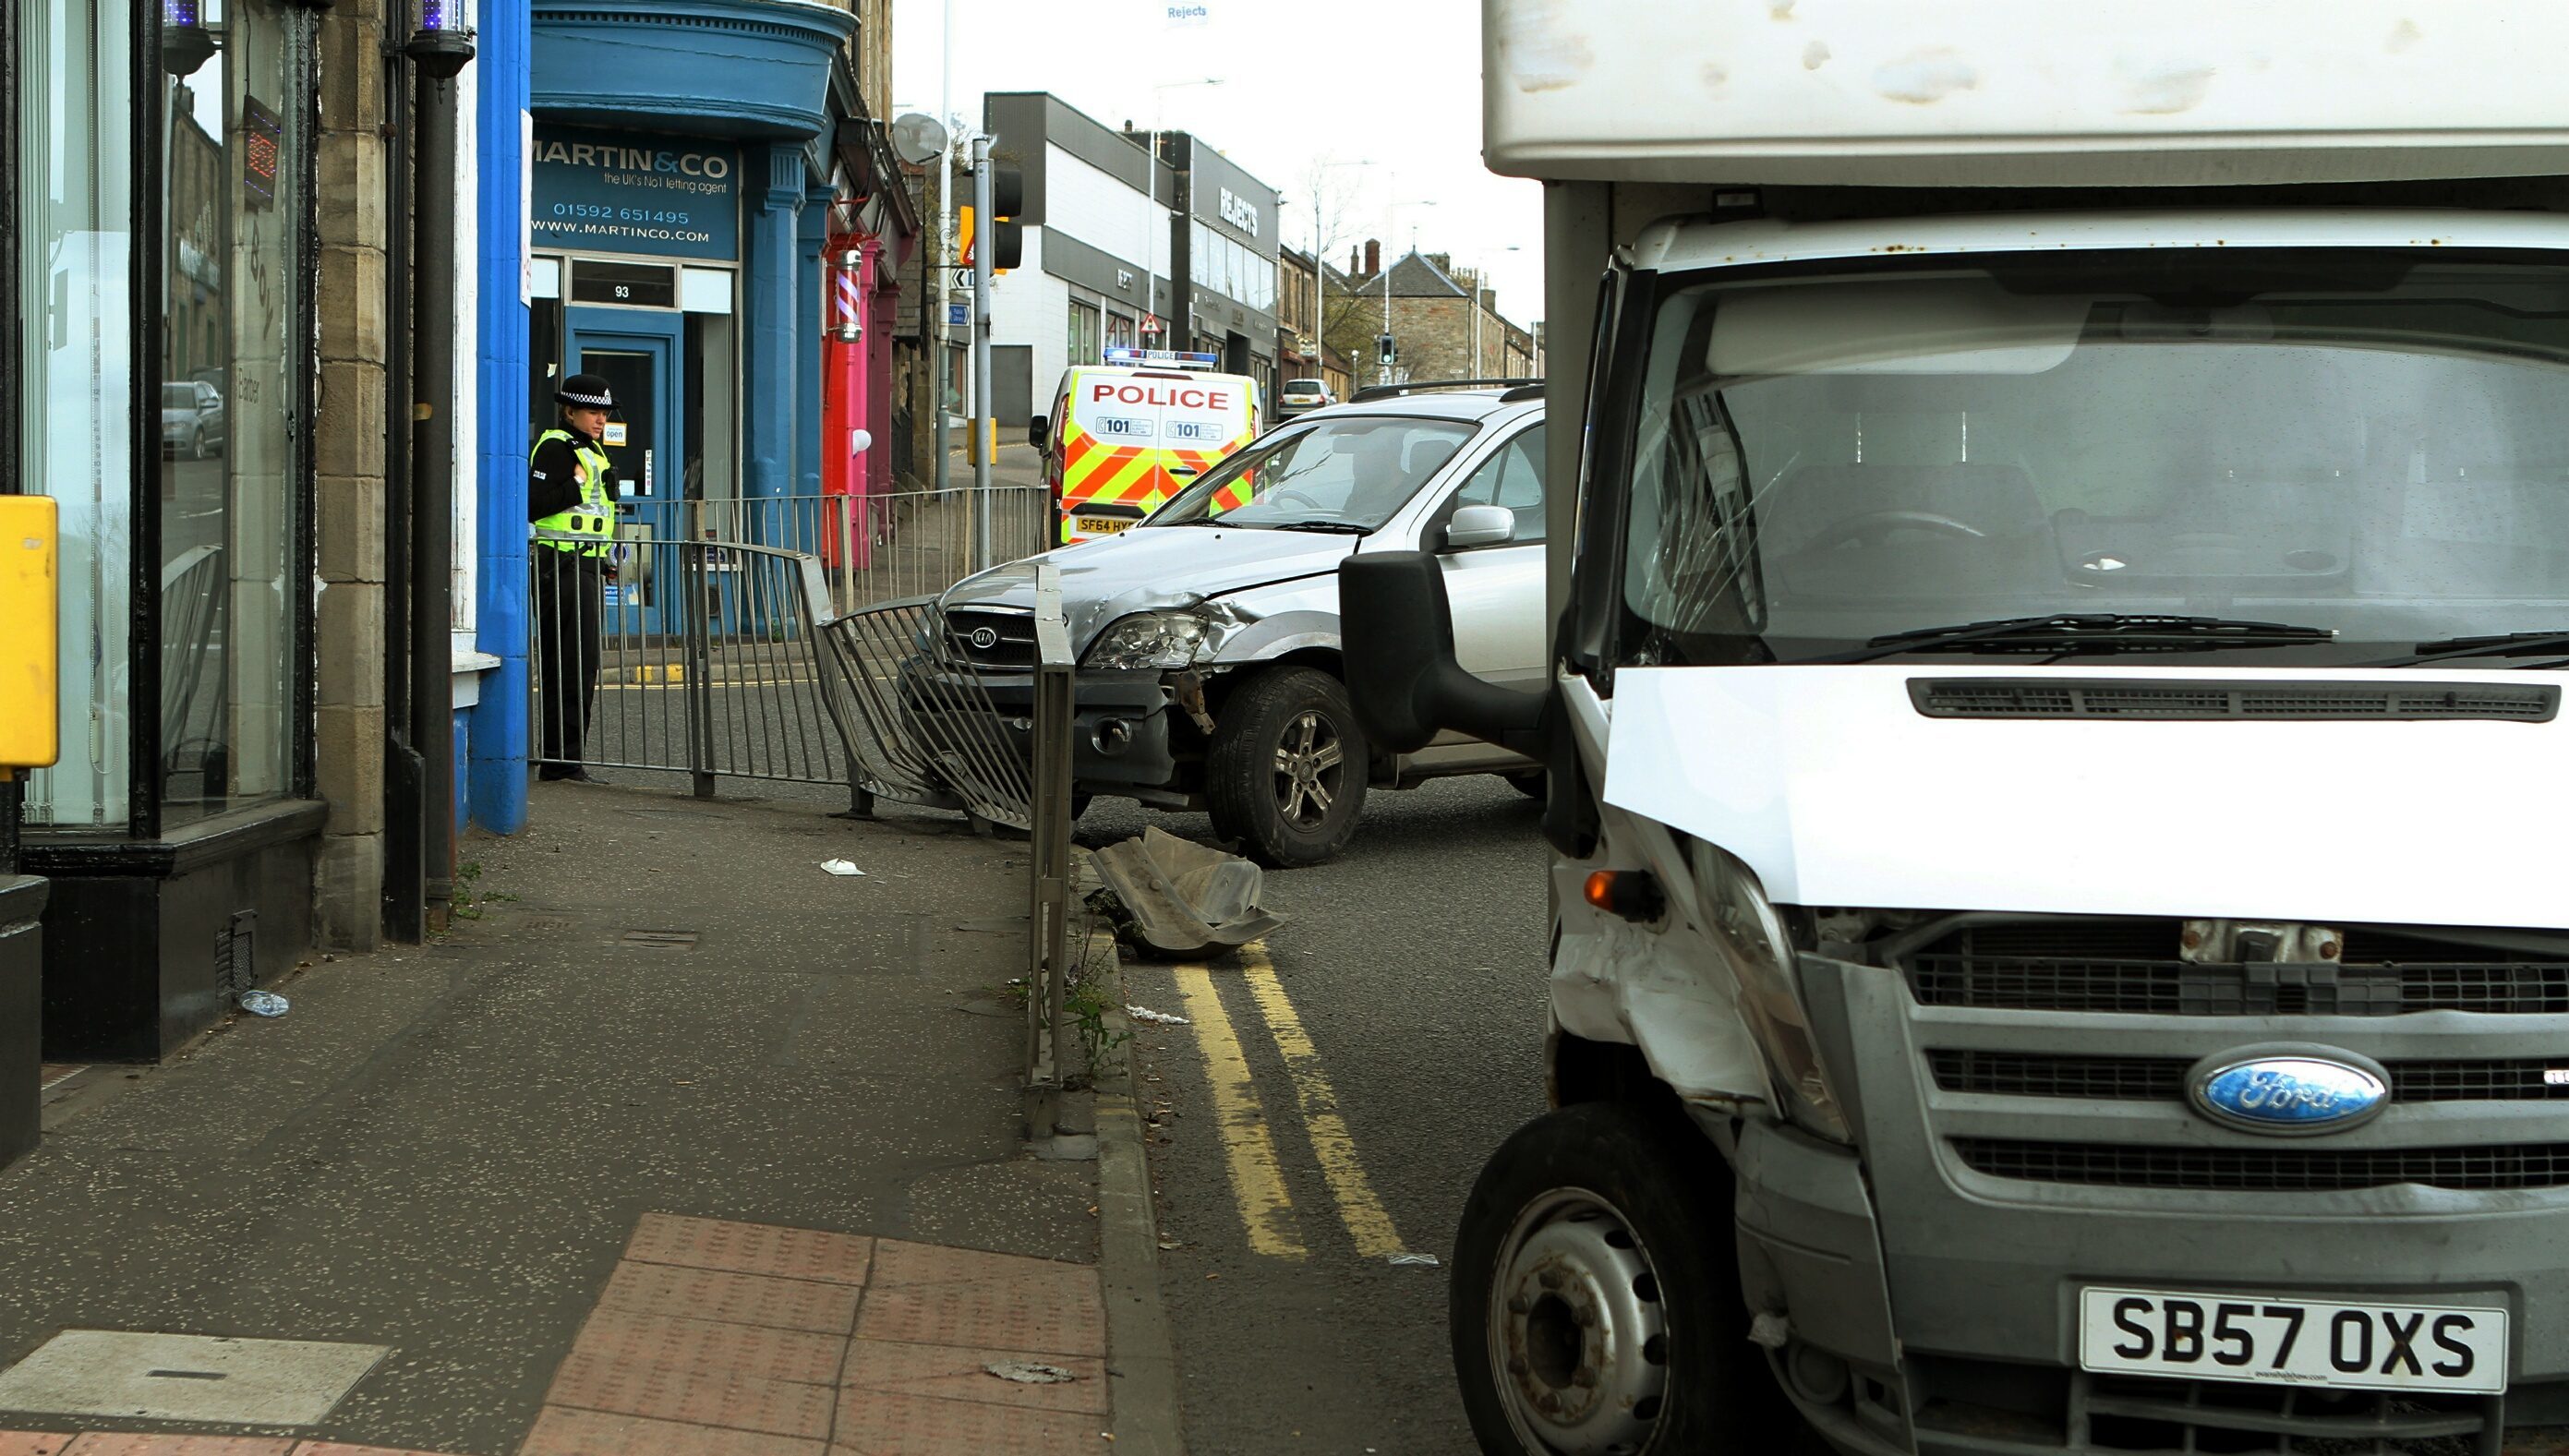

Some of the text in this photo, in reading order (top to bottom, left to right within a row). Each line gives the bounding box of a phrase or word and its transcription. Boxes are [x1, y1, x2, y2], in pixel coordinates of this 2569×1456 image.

[1167, 6, 1207, 18] Rejects
[604, 173, 727, 195] the UK's No1 letting agent
[553, 203, 689, 224] 01592 651495
[1219, 187, 1258, 237] REJECTS
[615, 285, 630, 298] 93
[1148, 350, 1175, 360] POLICE
[238, 367, 259, 404] Barber
[1092, 384, 1229, 411] POLICE
[1106, 419, 1129, 433] 101
[1176, 424, 1200, 438] 101
[1081, 519, 1110, 531] SF64
[975, 632, 992, 643] KIA
[2238, 1069, 2340, 1110] Ford
[2113, 1296, 2476, 1378] SB57 OXS
